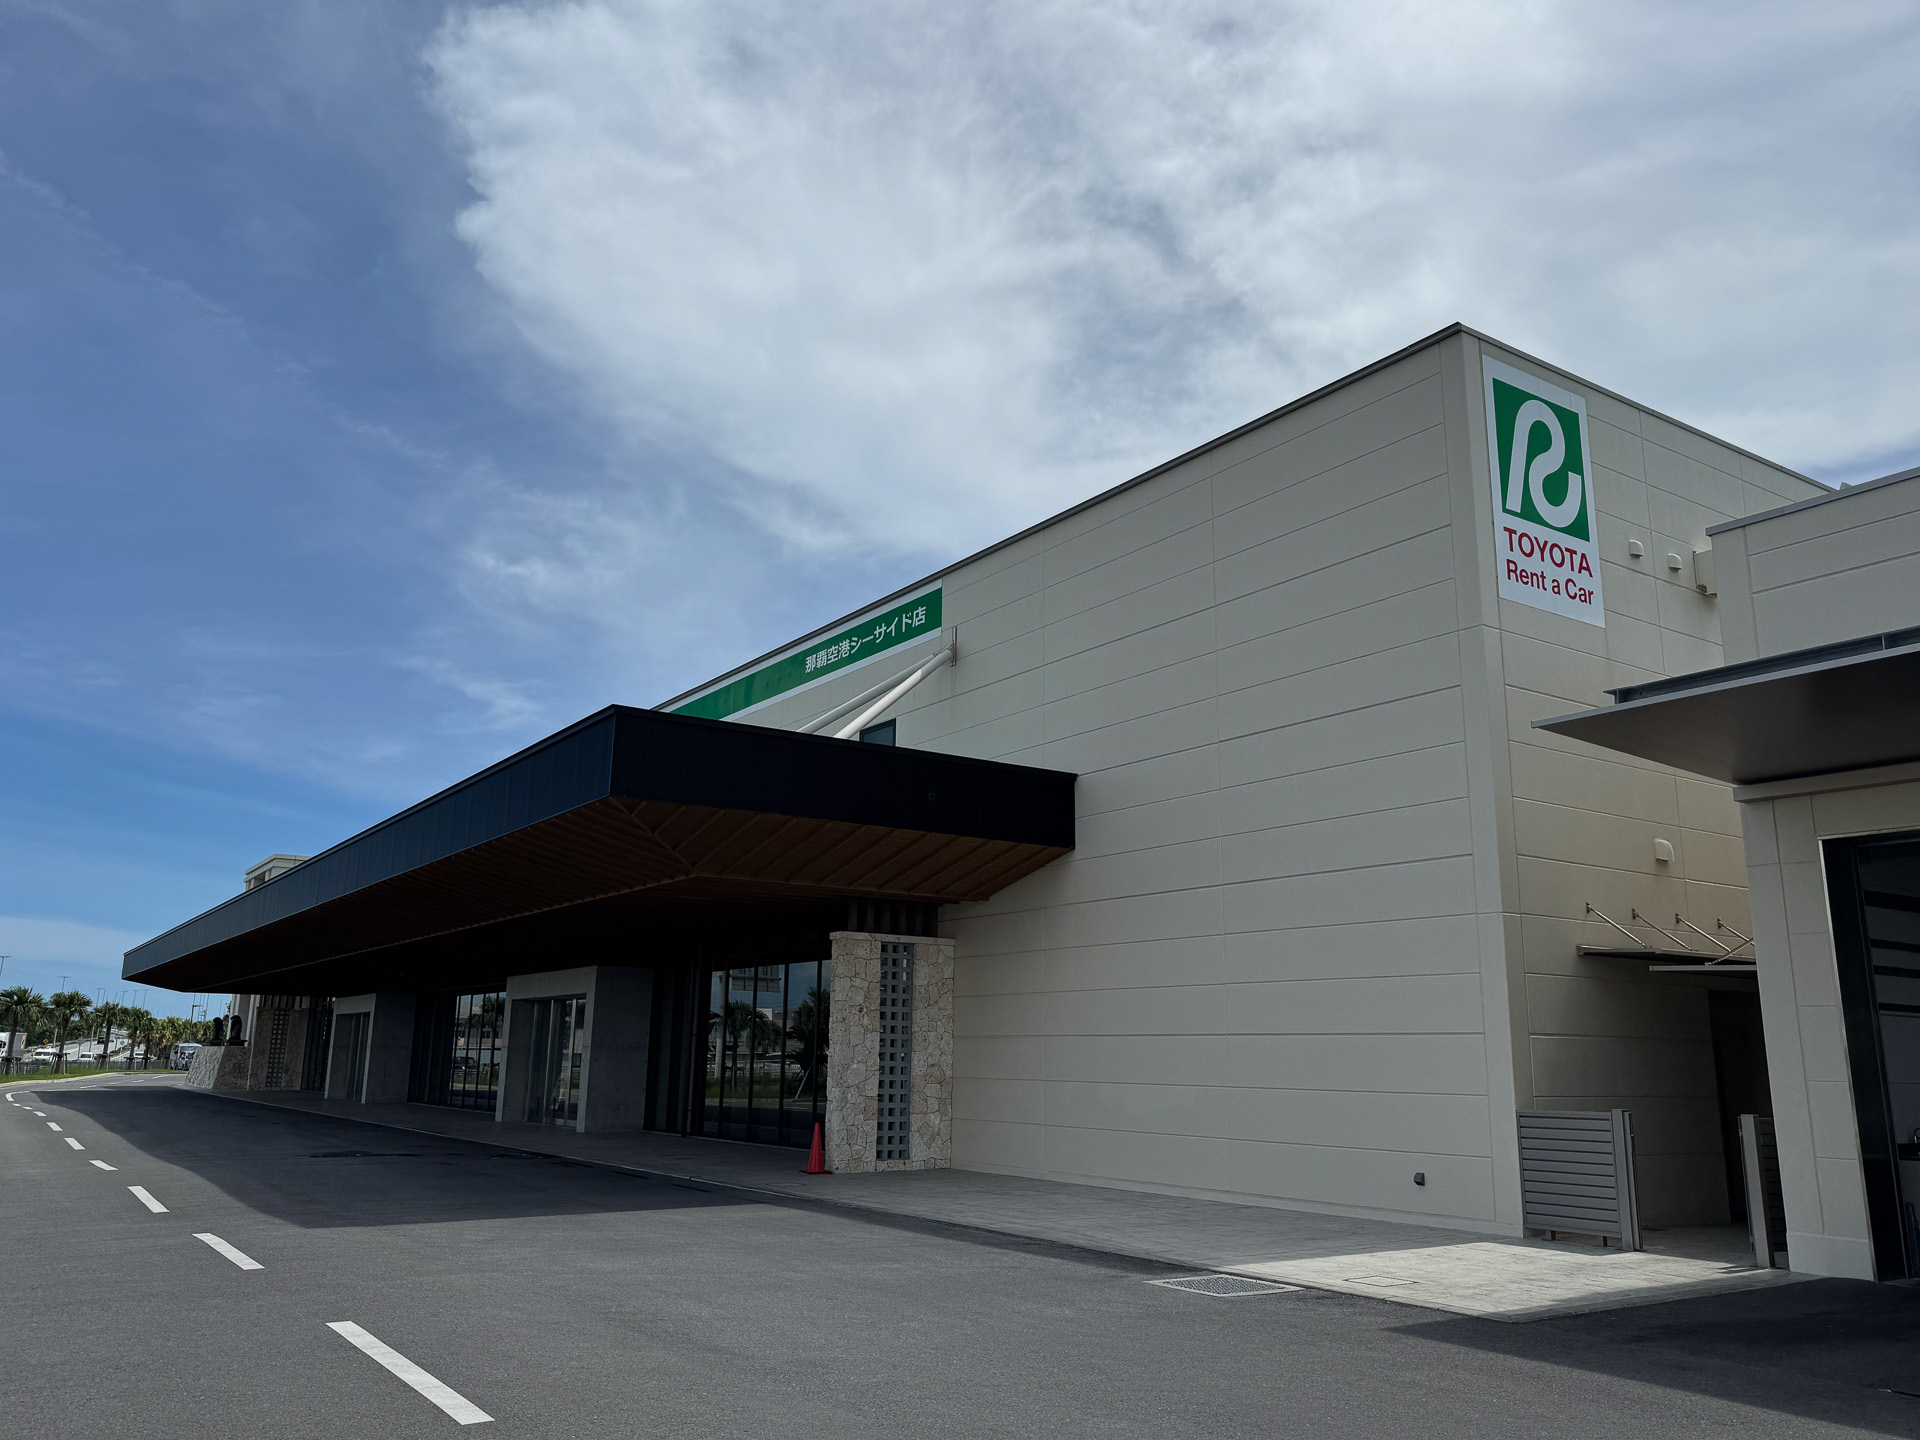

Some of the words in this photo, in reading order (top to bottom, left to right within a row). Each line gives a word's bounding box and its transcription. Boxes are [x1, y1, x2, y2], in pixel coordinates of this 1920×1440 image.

[1503, 526, 1593, 578] TOYOTA
[1506, 559, 1547, 592] Rent
[1551, 578, 1561, 596] a
[1565, 578, 1594, 605] Car
[805, 606, 926, 673] 那覇空港シーサイド店
